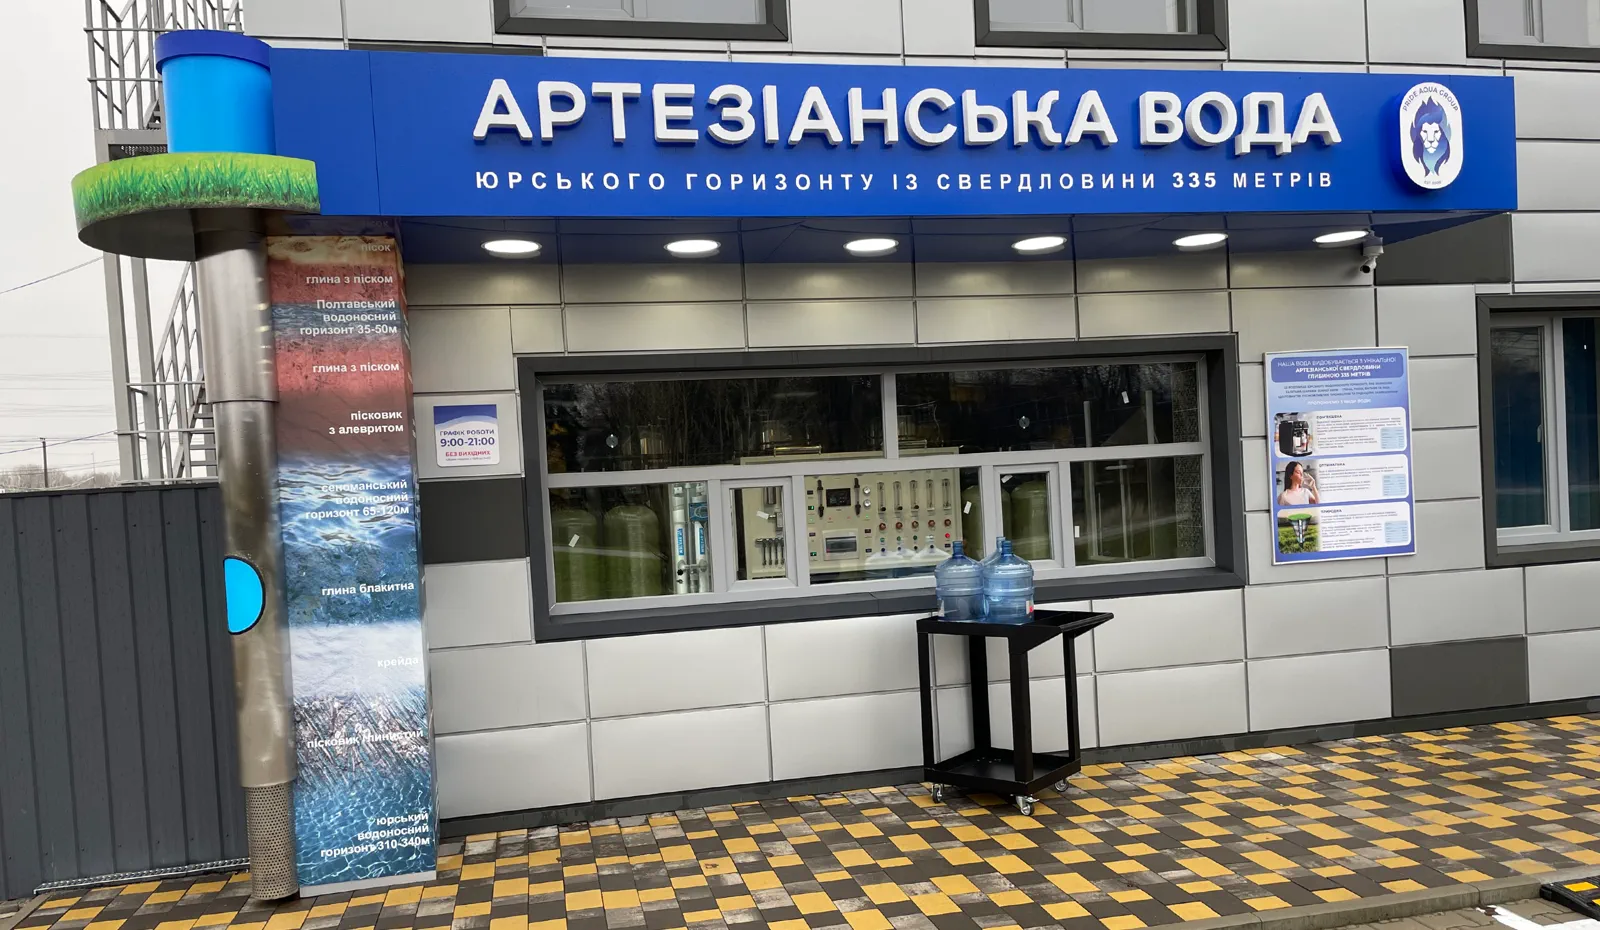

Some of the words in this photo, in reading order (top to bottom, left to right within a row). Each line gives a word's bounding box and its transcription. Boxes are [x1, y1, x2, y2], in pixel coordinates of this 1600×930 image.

[1403, 91, 1418, 111] PRIDE
[1419, 86, 1438, 95] AQUA
[1439, 89, 1459, 112] GROUP
[473, 78, 1117, 146] АРТЕЗІАНСЬКА
[1138, 91, 1342, 156] ВОДА
[475, 171, 665, 191] ЮРСЬКОГО
[685, 173, 874, 192] ГОРИЗОНТУ
[892, 173, 919, 191] ІЗ
[936, 172, 1157, 193] СВЕРДЛОВИНИ
[1171, 172, 1217, 189] 335
[1232, 172, 1334, 189] МЕТРІВ
[361, 244, 391, 252] пісок
[306, 275, 341, 284] глина
[344, 276, 350, 284] з
[353, 274, 393, 284] піском
[316, 298, 396, 310] Полтавський
[323, 312, 397, 324] водоносний
[300, 326, 354, 337] горизонт
[357, 325, 398, 334] 35-50м
[312, 363, 347, 373] глина
[350, 364, 357, 372] з
[360, 361, 400, 373] піском
[350, 409, 403, 421] пісковик
[329, 427, 336, 435] з
[338, 423, 404, 435] алевритом
[440, 437, 495, 447] 9:00-21:00
[321, 479, 408, 493] сеноманський
[335, 492, 409, 506] водоносний
[305, 508, 360, 520] горизонт
[362, 505, 410, 516] 65-120м
[321, 587, 356, 597] глина
[359, 581, 415, 594] блакитна
[377, 655, 419, 669] крейда
[306, 735, 360, 749] пісковик
[376, 811, 429, 826] юрський
[357, 824, 429, 841] водоносний
[320, 844, 374, 858] горизонт
[377, 836, 430, 851] 310-340м
